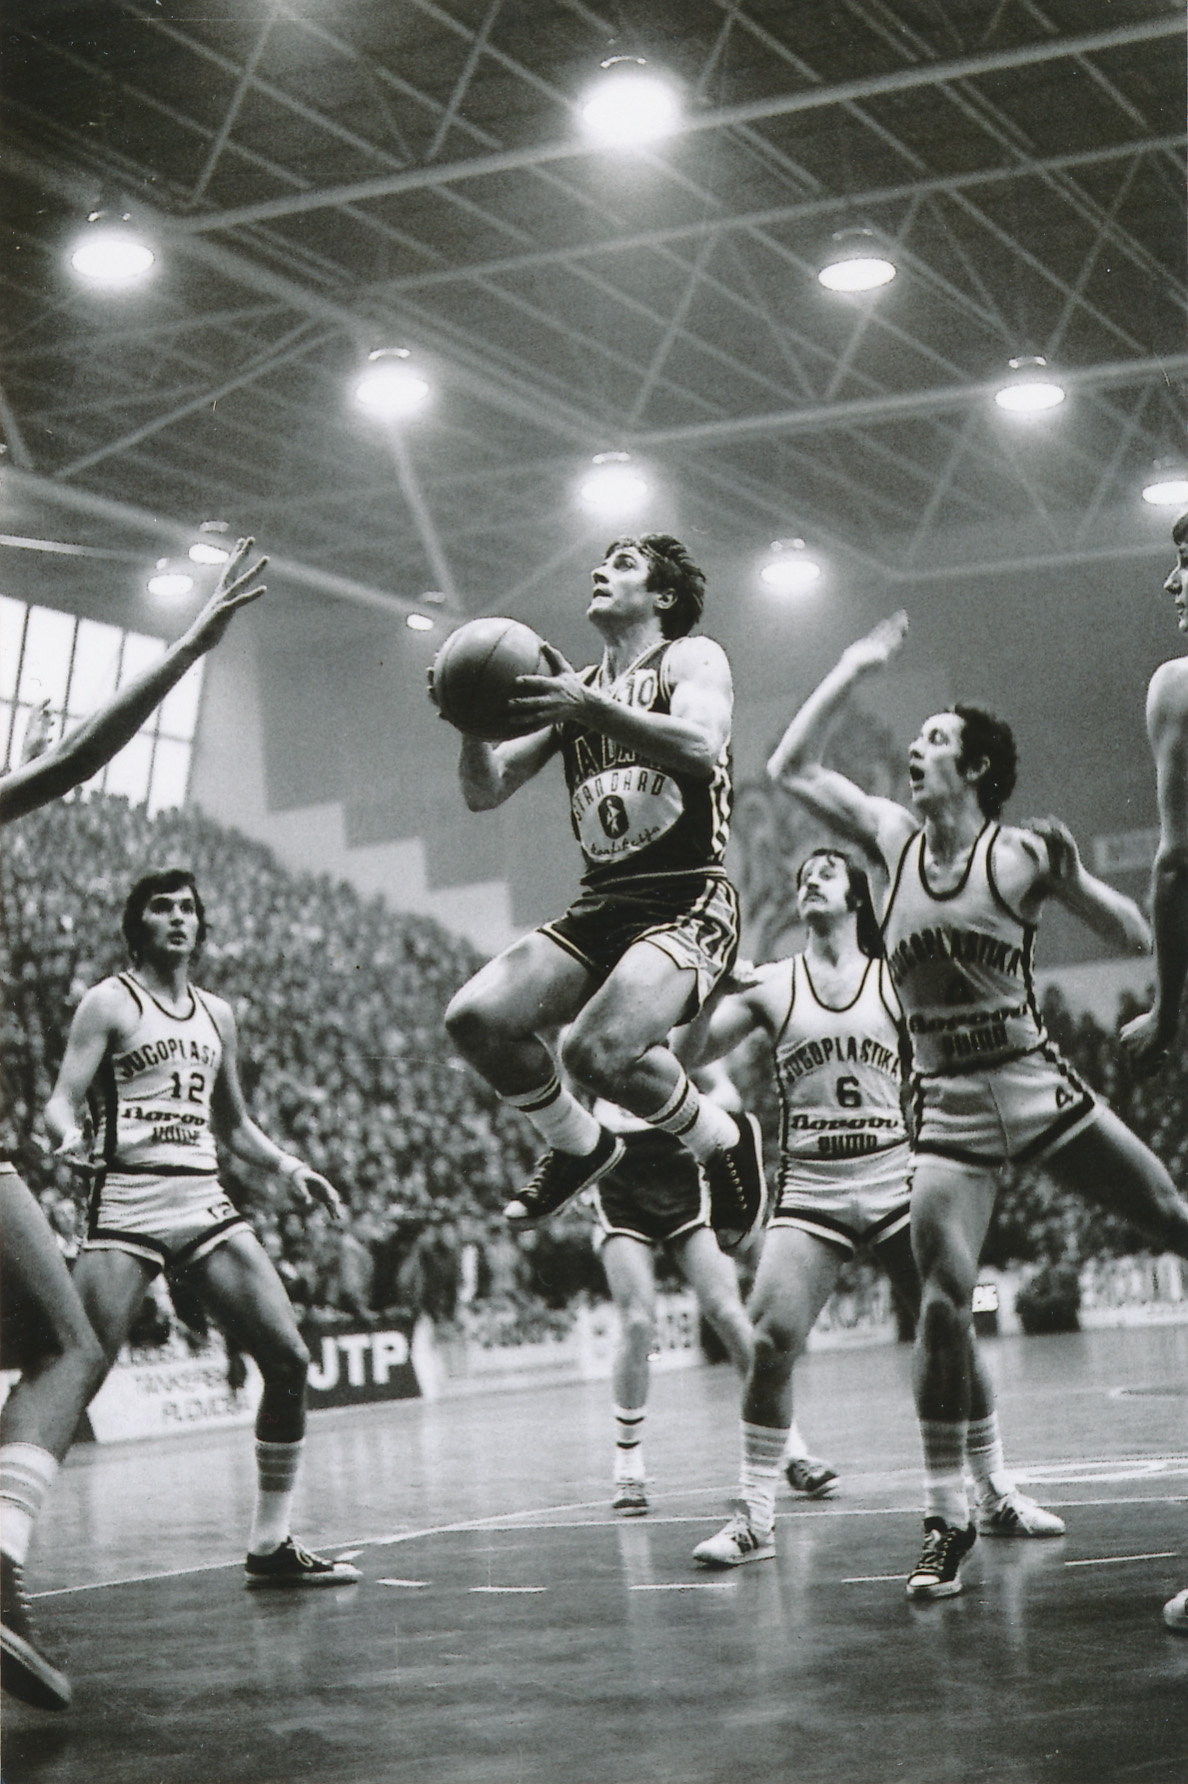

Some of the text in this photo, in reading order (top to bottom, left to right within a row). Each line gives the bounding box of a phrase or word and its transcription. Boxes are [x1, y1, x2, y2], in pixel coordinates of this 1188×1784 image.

[573, 770, 666, 822] STANDARD
[171, 1071, 205, 1104] 12
[836, 1076, 861, 1108] 6
